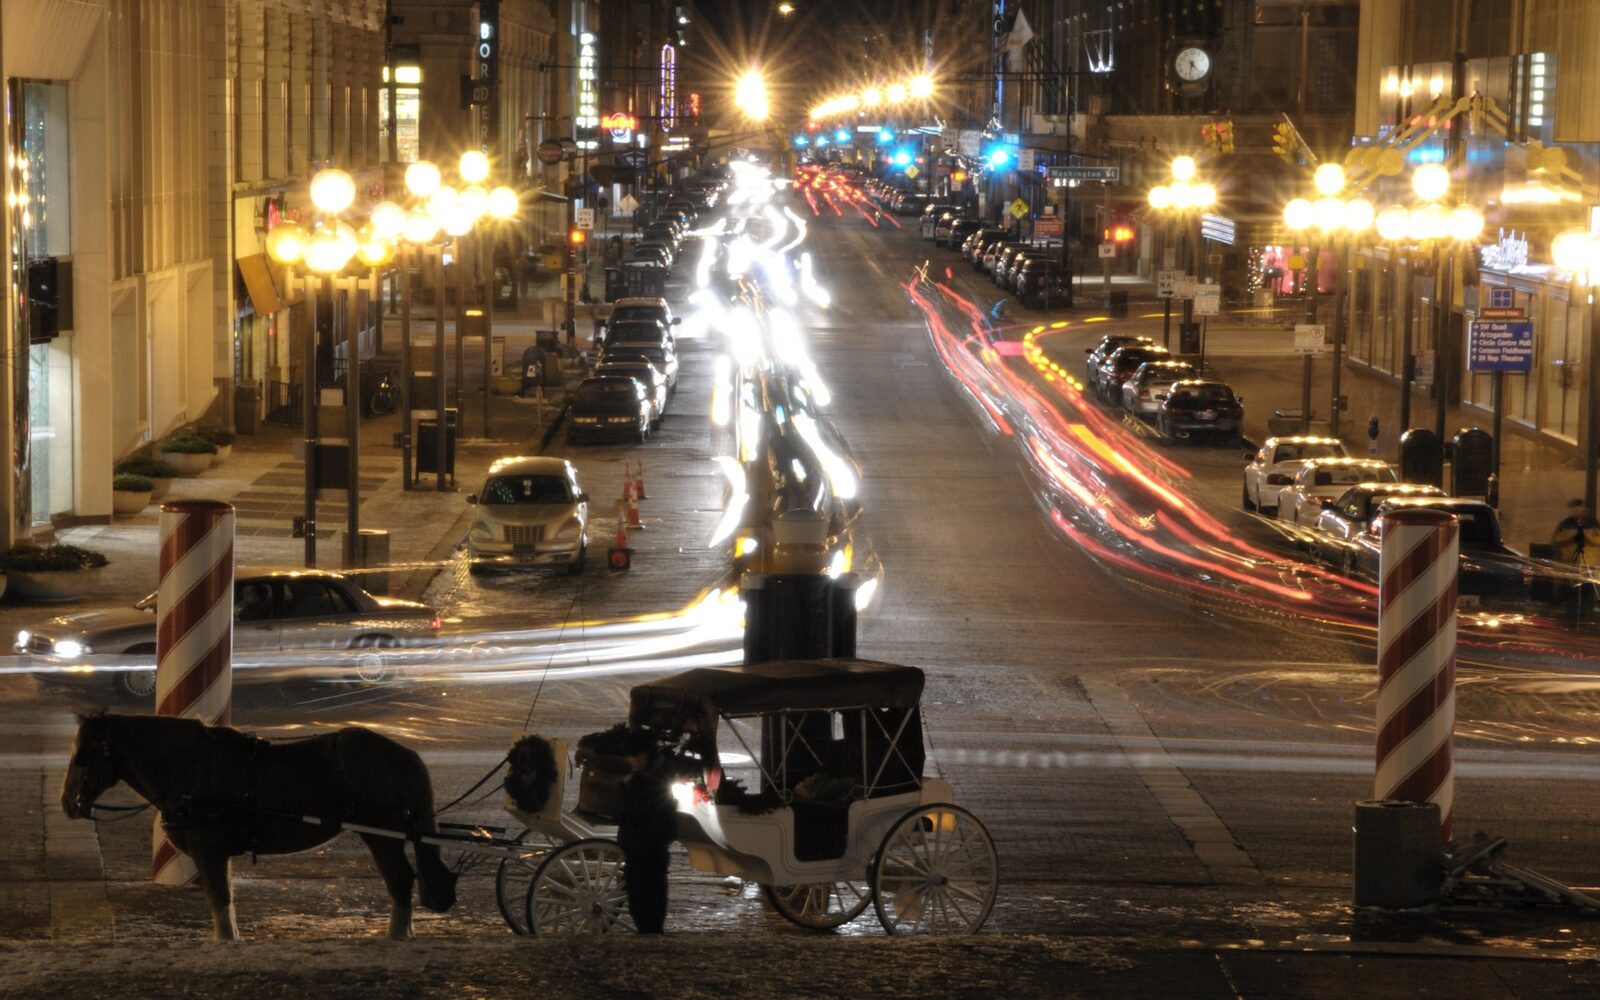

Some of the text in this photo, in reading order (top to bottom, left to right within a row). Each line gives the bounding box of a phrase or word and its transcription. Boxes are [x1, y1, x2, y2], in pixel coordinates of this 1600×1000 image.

[480, 22, 490, 156] BORDERS
[579, 33, 595, 116] PARKING
[1051, 170, 1101, 178] Washington
